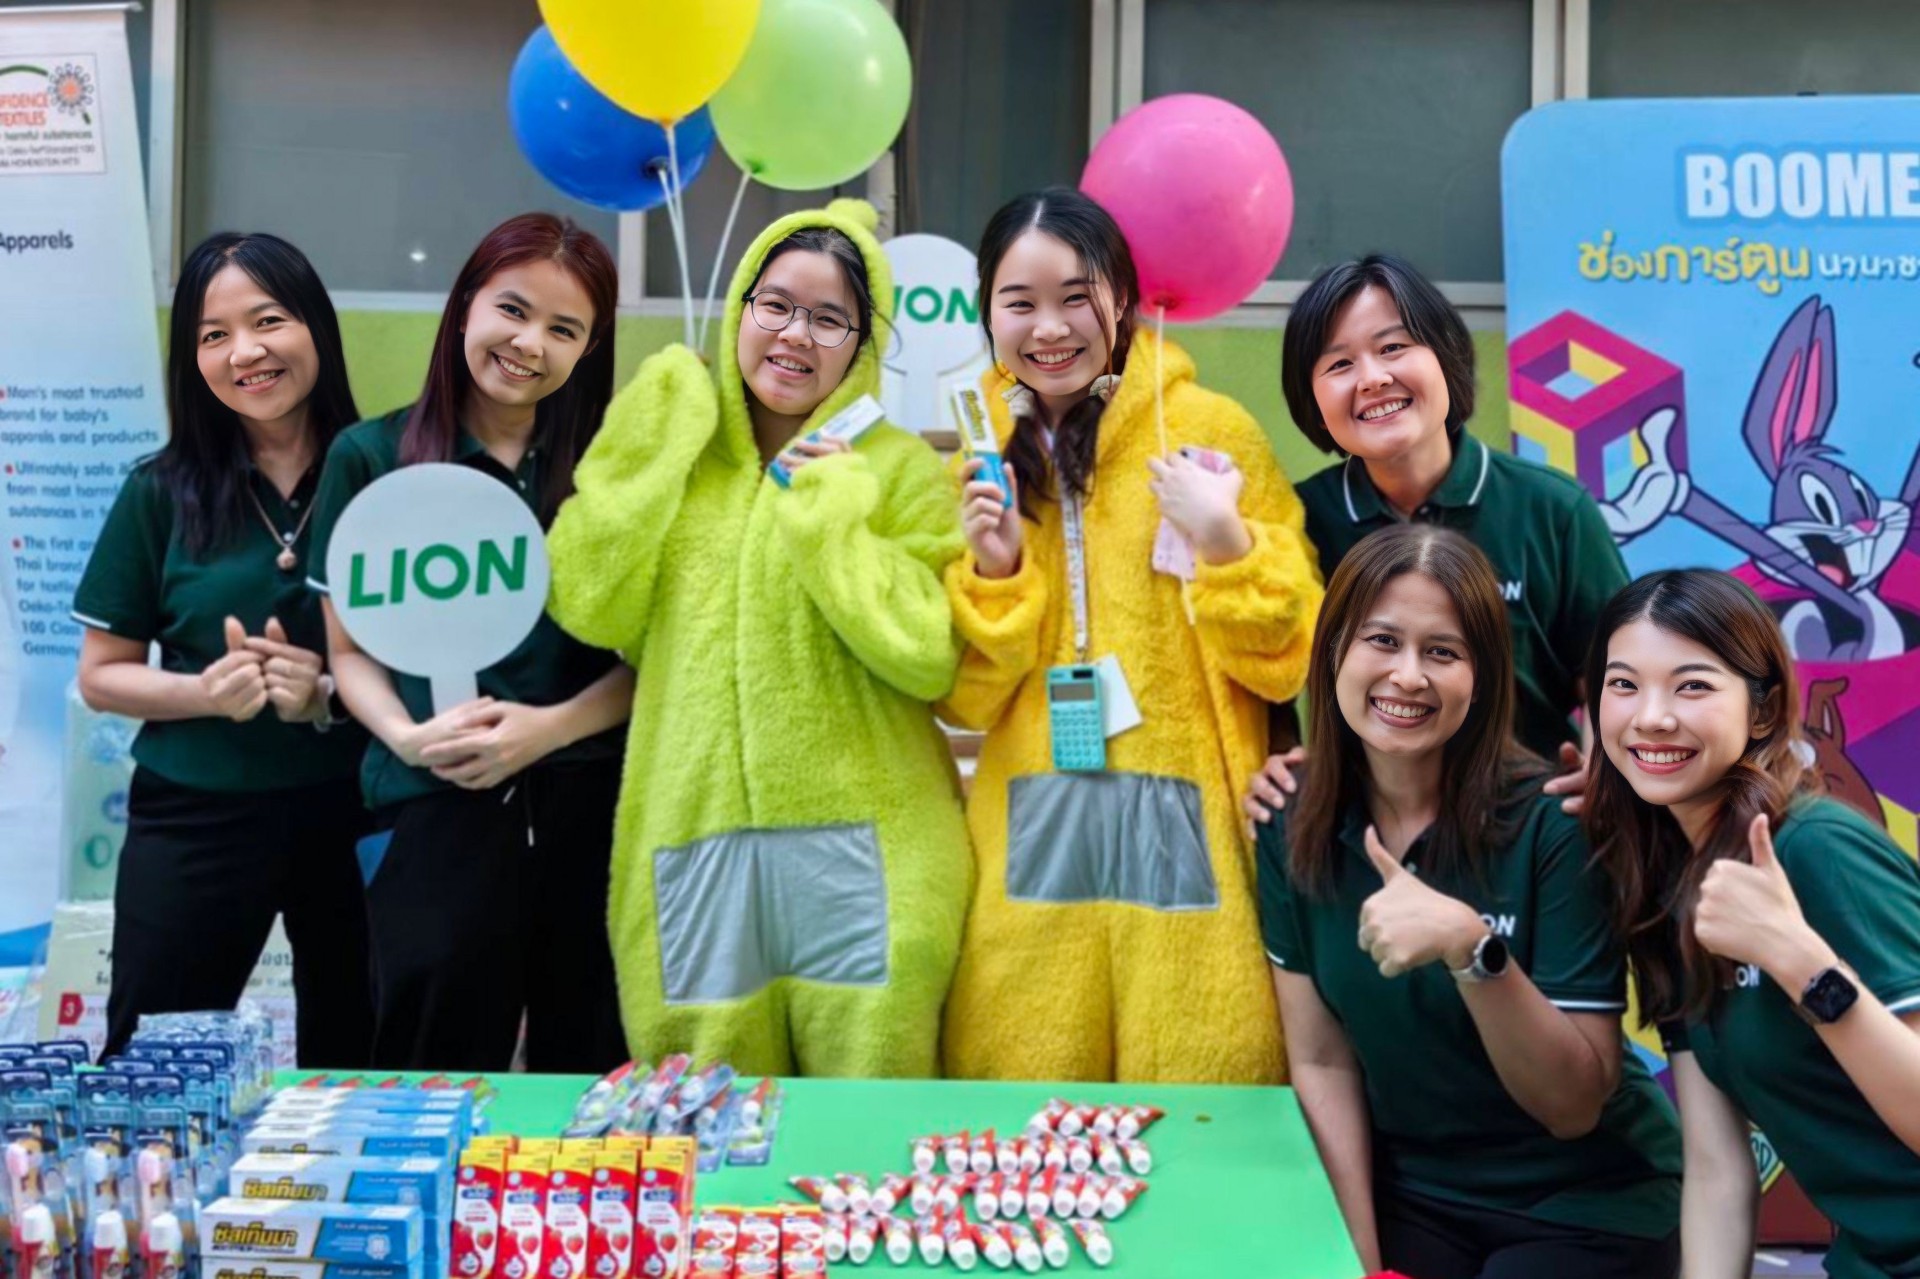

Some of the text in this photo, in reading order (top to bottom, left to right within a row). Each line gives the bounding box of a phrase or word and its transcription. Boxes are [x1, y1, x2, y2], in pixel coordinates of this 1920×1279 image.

[1685, 153, 1920, 219] BOOME
[0, 230, 74, 254] Apparels
[1577, 230, 1920, 294] ช่องการ์ตูน นานาช
[52, 386, 84, 399] most
[90, 384, 144, 399] trusted
[40, 409, 57, 422] for
[63, 408, 109, 425] baby's
[60, 430, 85, 444] and
[92, 429, 158, 446] products
[84, 462, 115, 476] safe
[7, 482, 37, 496] from
[41, 484, 71, 497] most
[9, 506, 76, 519] substances
[81, 506, 94, 518] in
[24, 536, 46, 551] The
[50, 537, 74, 551] first
[14, 556, 42, 571] Thai
[347, 535, 528, 608] LION
[17, 578, 35, 592] for
[22, 620, 46, 635] 100
